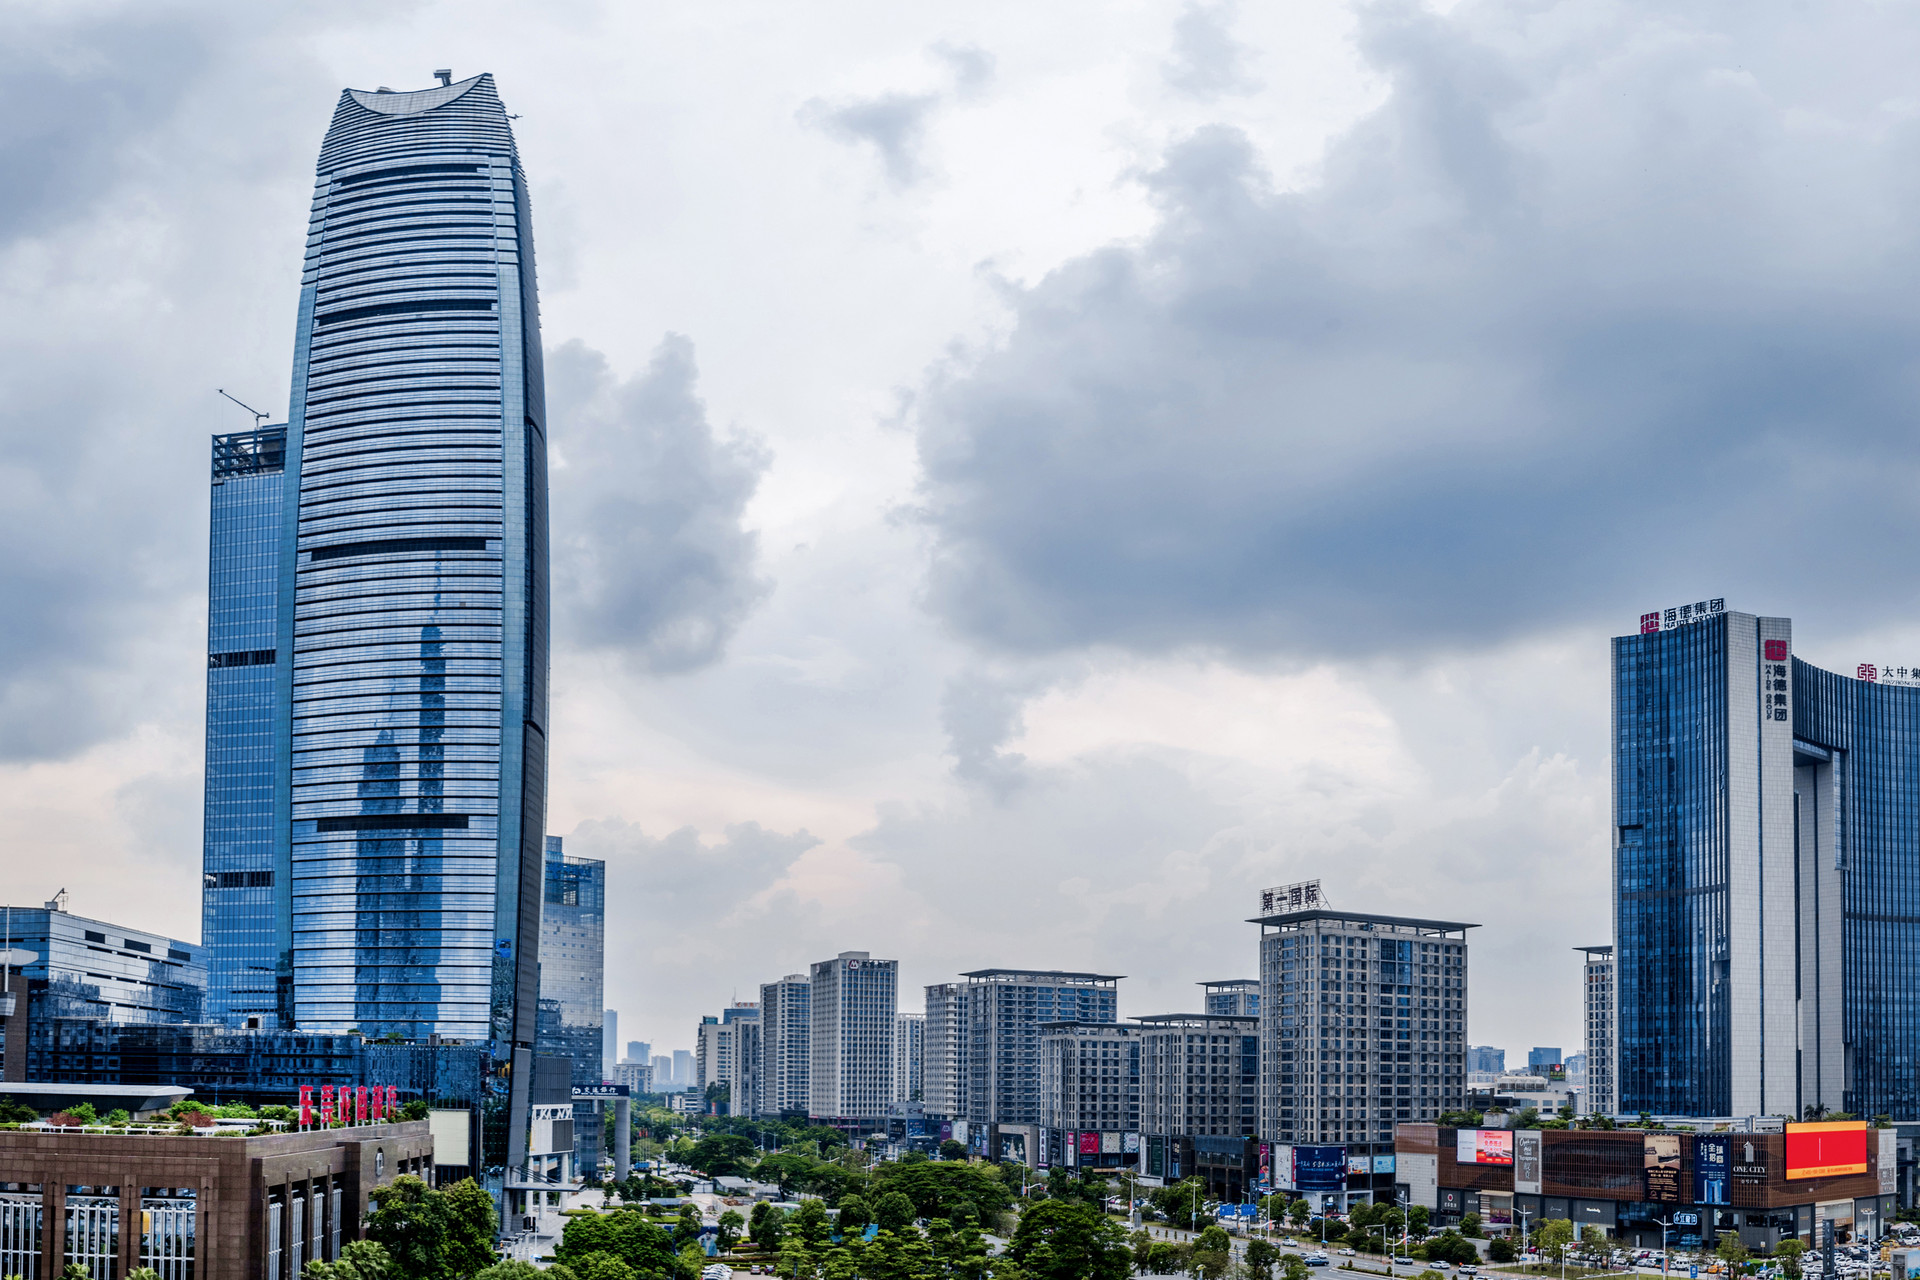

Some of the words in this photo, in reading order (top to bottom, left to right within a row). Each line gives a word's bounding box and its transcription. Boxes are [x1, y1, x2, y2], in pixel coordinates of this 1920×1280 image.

[1664, 598, 1724, 622] 海德集团
[1773, 664, 1787, 721] 海德集团
[1262, 884, 1317, 912] 第一国际
[1732, 1165, 1749, 1173] ONE
[1749, 1165, 1766, 1174] CITY
